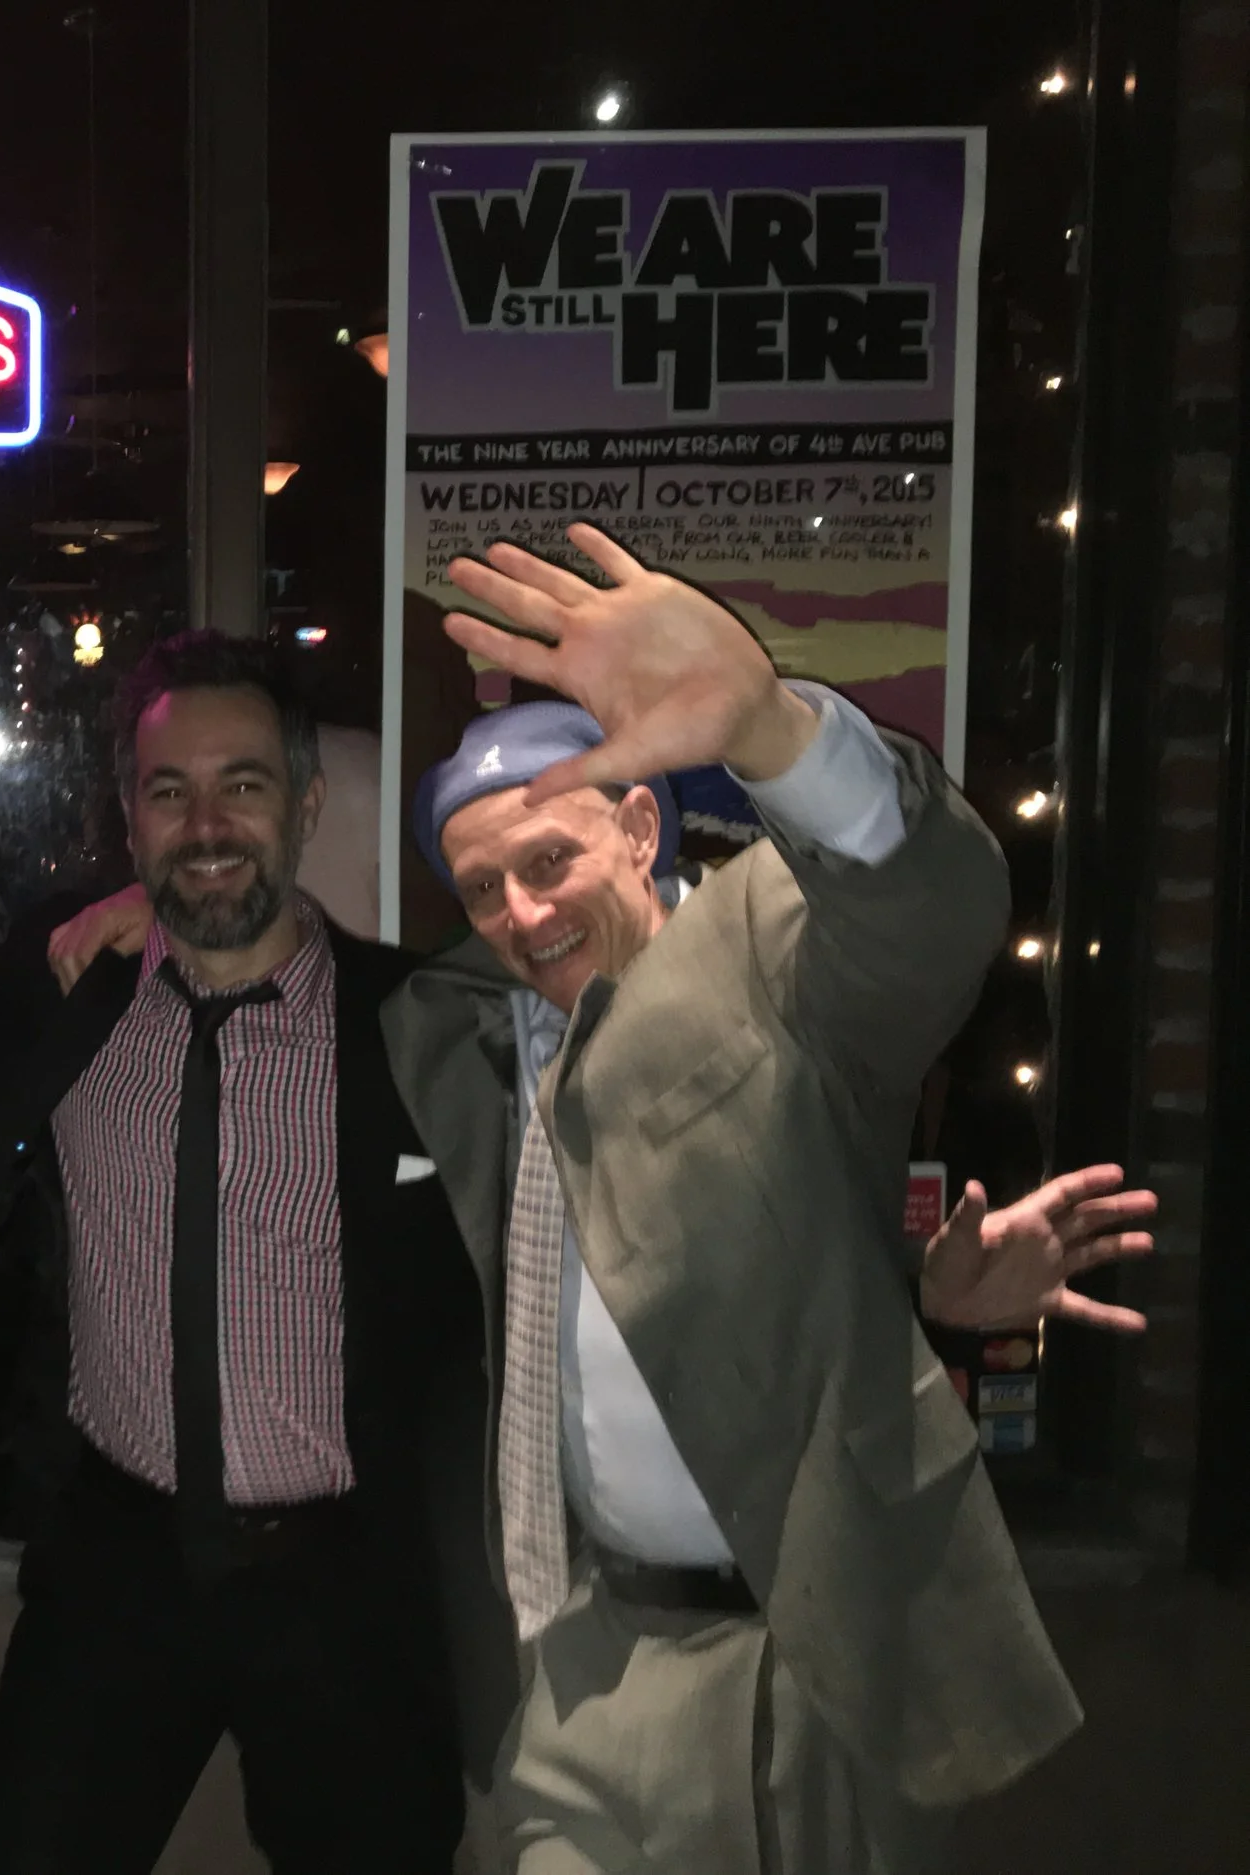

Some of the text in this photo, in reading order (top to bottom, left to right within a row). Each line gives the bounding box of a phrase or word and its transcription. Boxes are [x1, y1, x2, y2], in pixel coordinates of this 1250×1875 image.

[435, 166, 883, 325] WE ARE
[501, 289, 930, 411] STILL HERE
[417, 430, 947, 464] THE NINE YEAR ANNIVERSARY OF 4th AVE PUB
[421, 480, 630, 511] WEDNESDAY
[655, 478, 815, 507] OCTOBER
[872, 473, 936, 503] 2015
[428, 518, 467, 534] JOIN
[477, 517, 501, 532] US
[510, 517, 533, 531] AS
[588, 515, 687, 531] ELEBRATE
[698, 513, 739, 528] OUR
[672, 530, 720, 546] FROM
[657, 544, 692, 562] DAY
[820, 546, 859, 562] FUN
